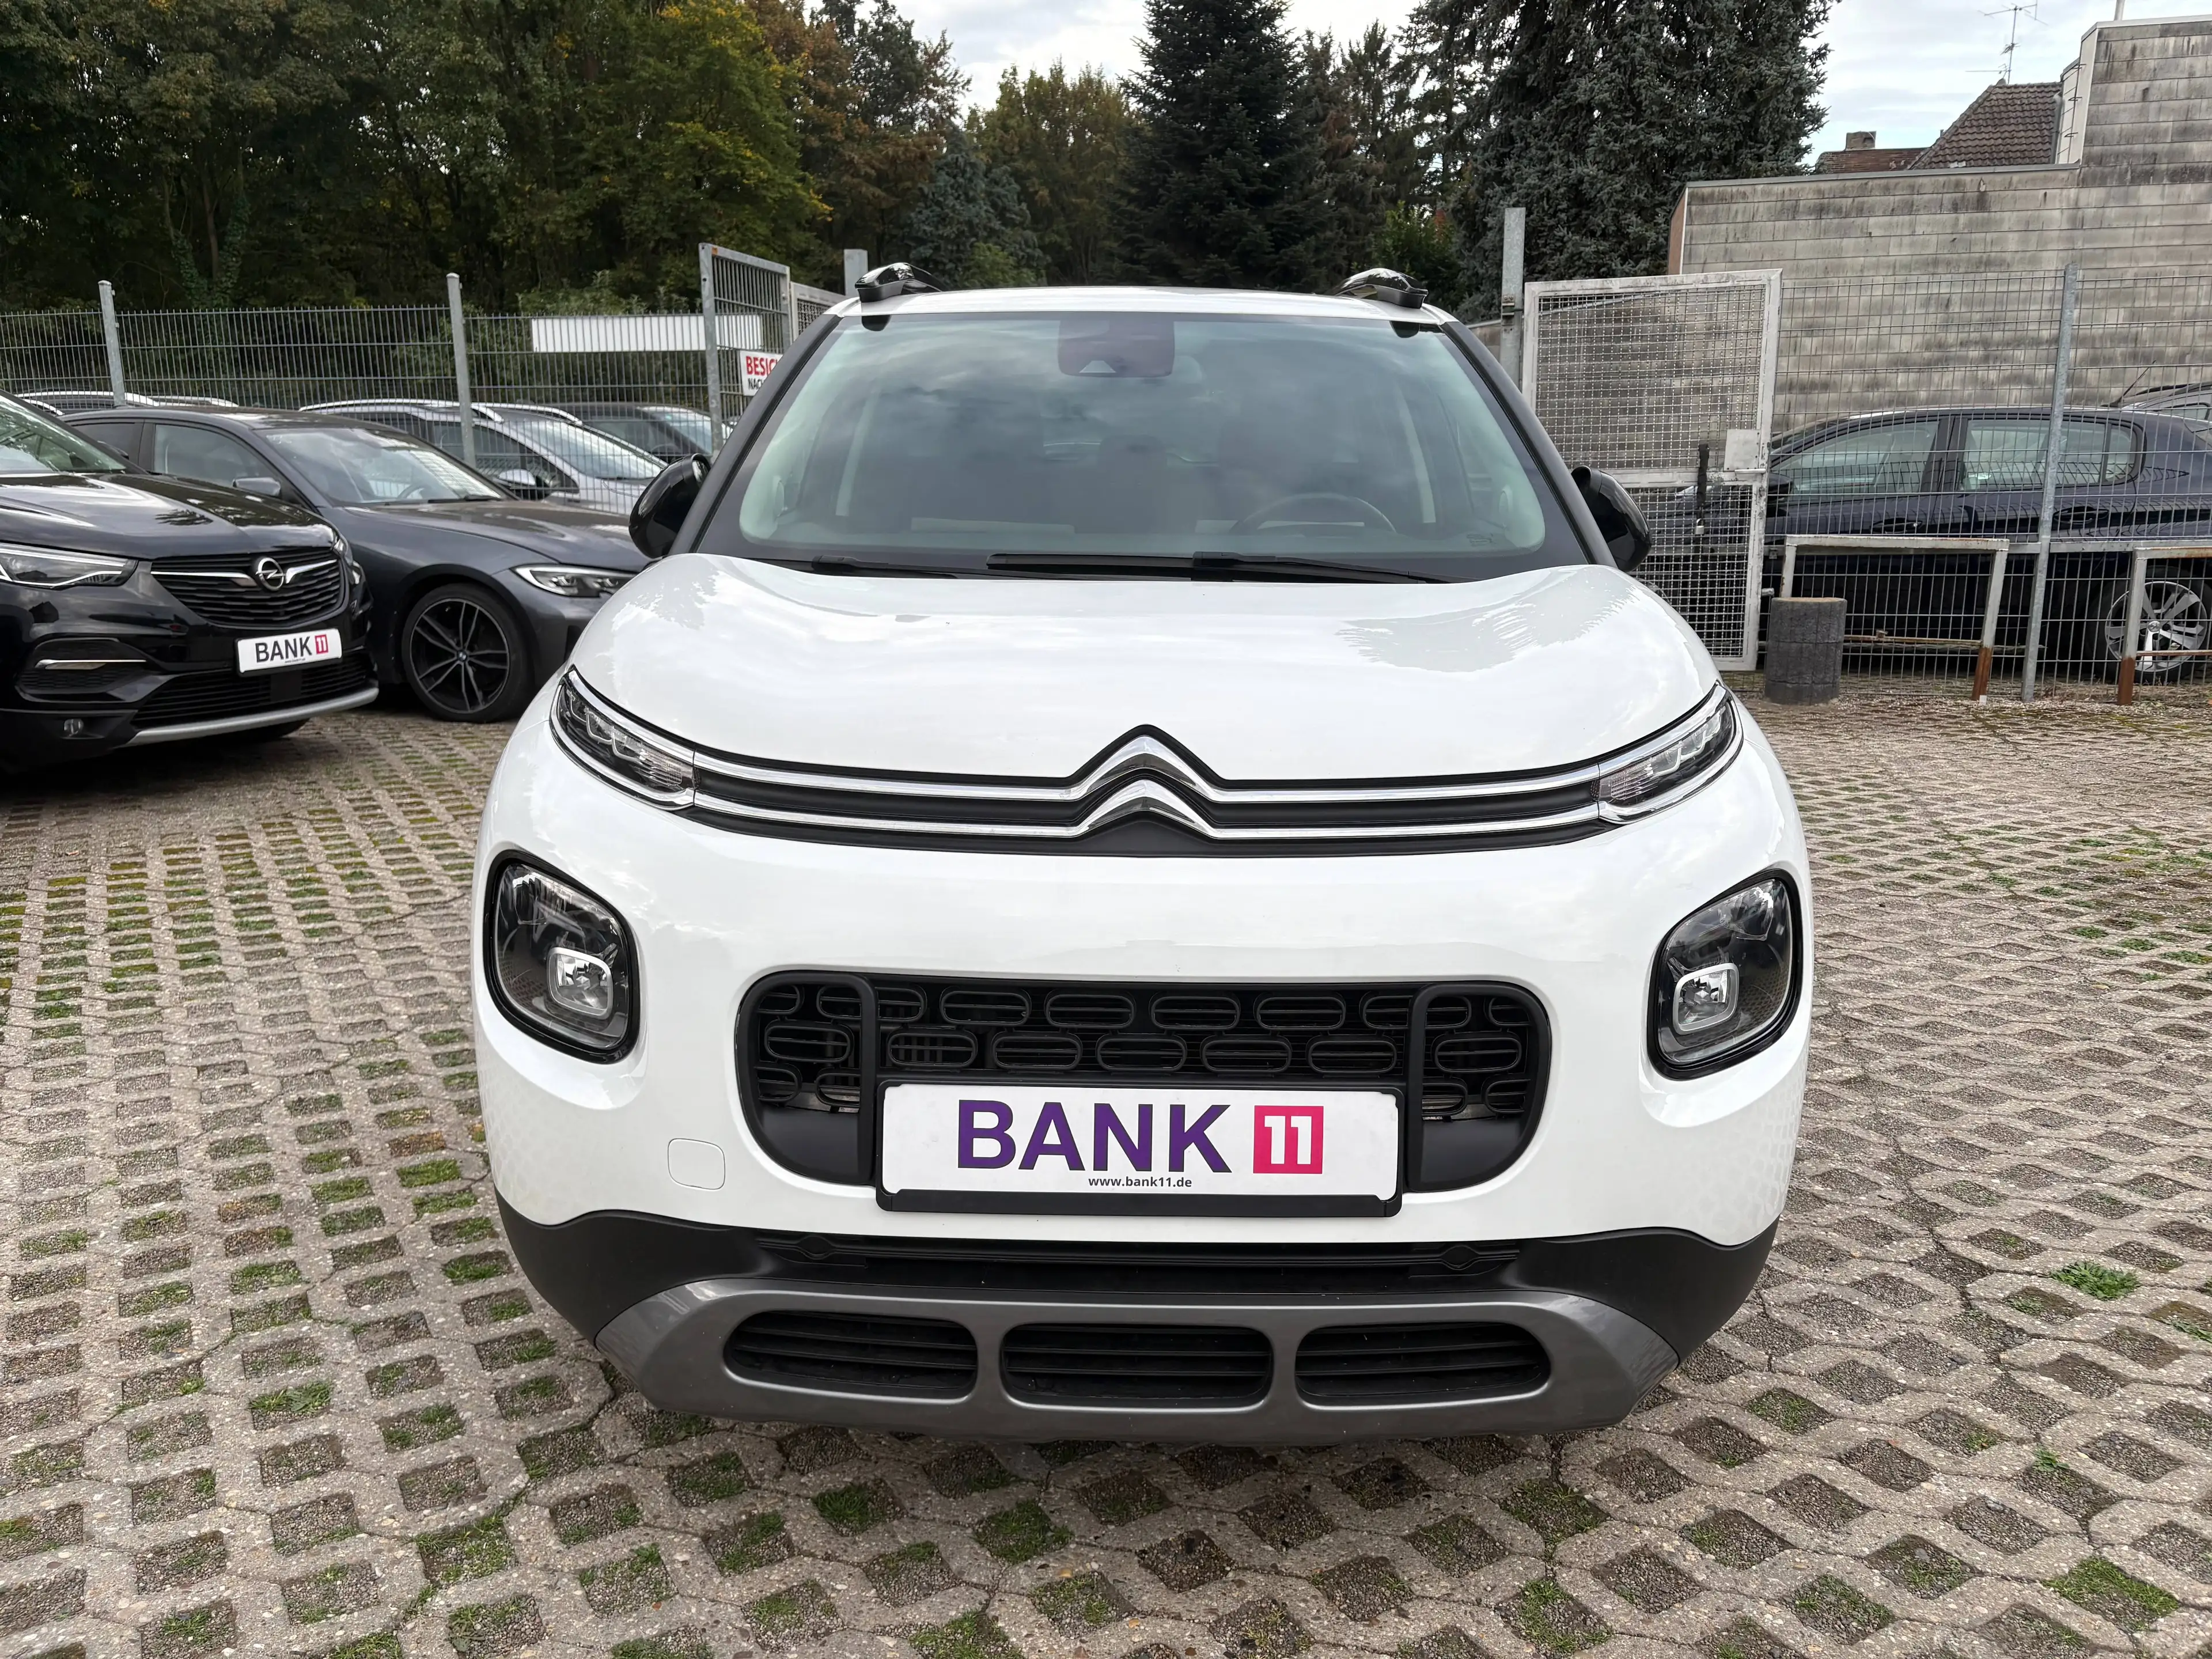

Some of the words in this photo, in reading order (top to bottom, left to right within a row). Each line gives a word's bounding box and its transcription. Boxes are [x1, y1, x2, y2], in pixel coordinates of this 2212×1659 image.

[746, 356, 778, 376] BESIC
[255, 637, 312, 663] BANK
[316, 637, 328, 653] 11
[958, 1100, 1232, 1173] BANK
[1262, 1113, 1313, 1166] 11
[1088, 1176, 1192, 1188] www.bank11.de
